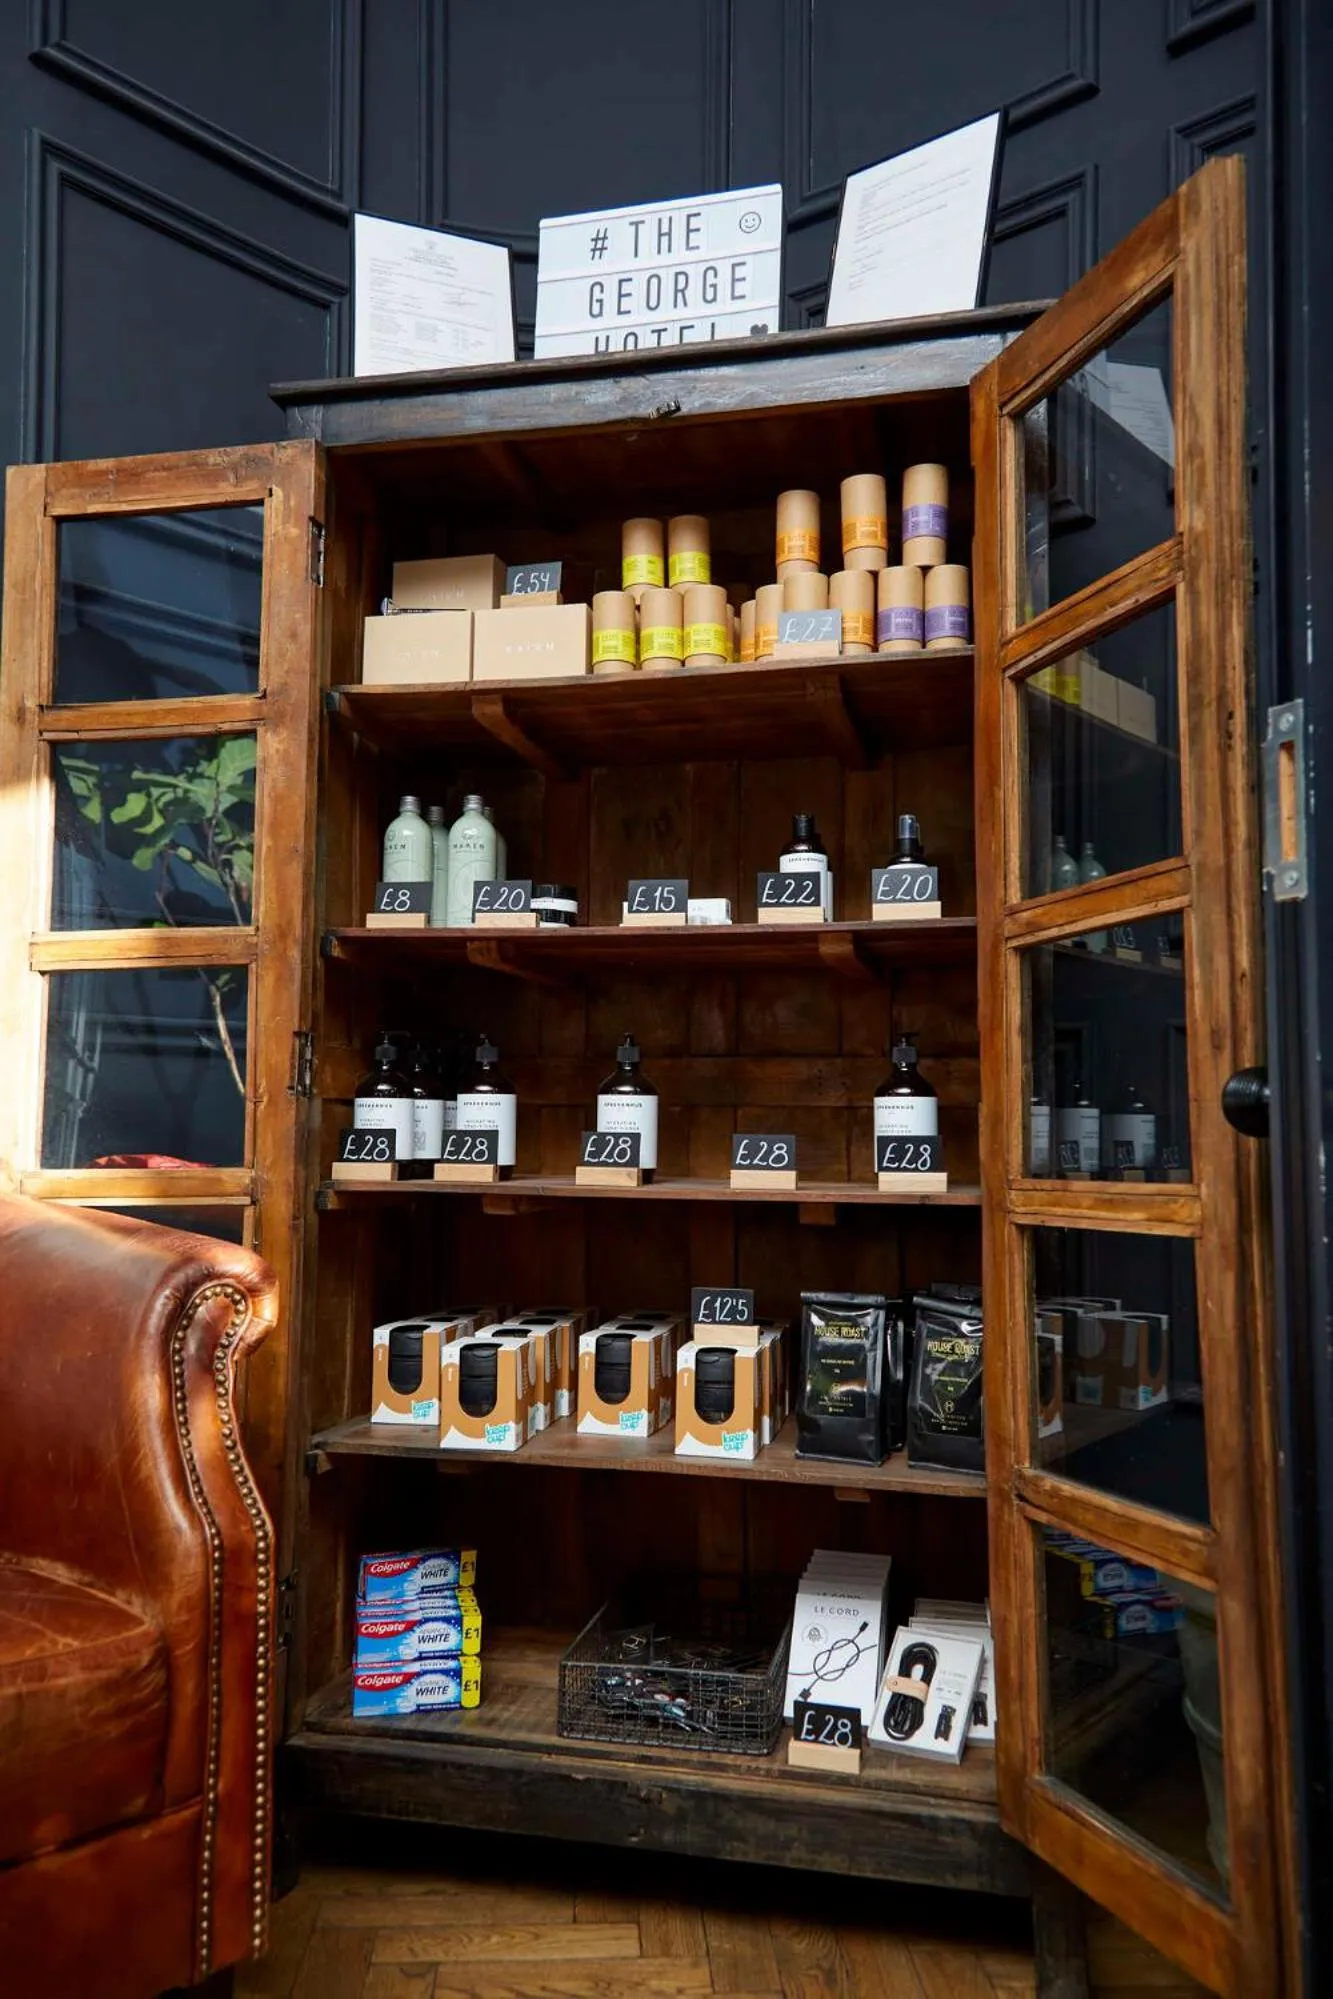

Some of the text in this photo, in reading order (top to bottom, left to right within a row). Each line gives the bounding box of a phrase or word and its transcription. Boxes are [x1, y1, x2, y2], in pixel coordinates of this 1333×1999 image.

[629, 212, 702, 258] THE
[589, 262, 746, 318] GEORGE
[784, 616, 833, 642] £27
[476, 885, 525, 911] £20
[632, 886, 676, 911] £15
[762, 878, 815, 903] £22
[877, 873, 933, 900] £20
[380, 888, 411, 911] £8
[343, 1135, 390, 1161] £28
[443, 1135, 489, 1162] £28
[583, 1135, 632, 1163] £28
[736, 1139, 789, 1168] £28
[882, 1143, 931, 1171] £28
[370, 1560, 410, 1574] Colgate
[420, 1568, 450, 1580] WHITE
[813, 1605, 860, 1617] LE CORD
[361, 1621, 406, 1634] Colgate
[417, 1633, 451, 1645] WHITE
[464, 1627, 480, 1639] £1
[357, 1673, 403, 1687] Colgate
[415, 1686, 449, 1697] WHITE
[463, 1680, 479, 1692] £1
[800, 1710, 853, 1749] £28
